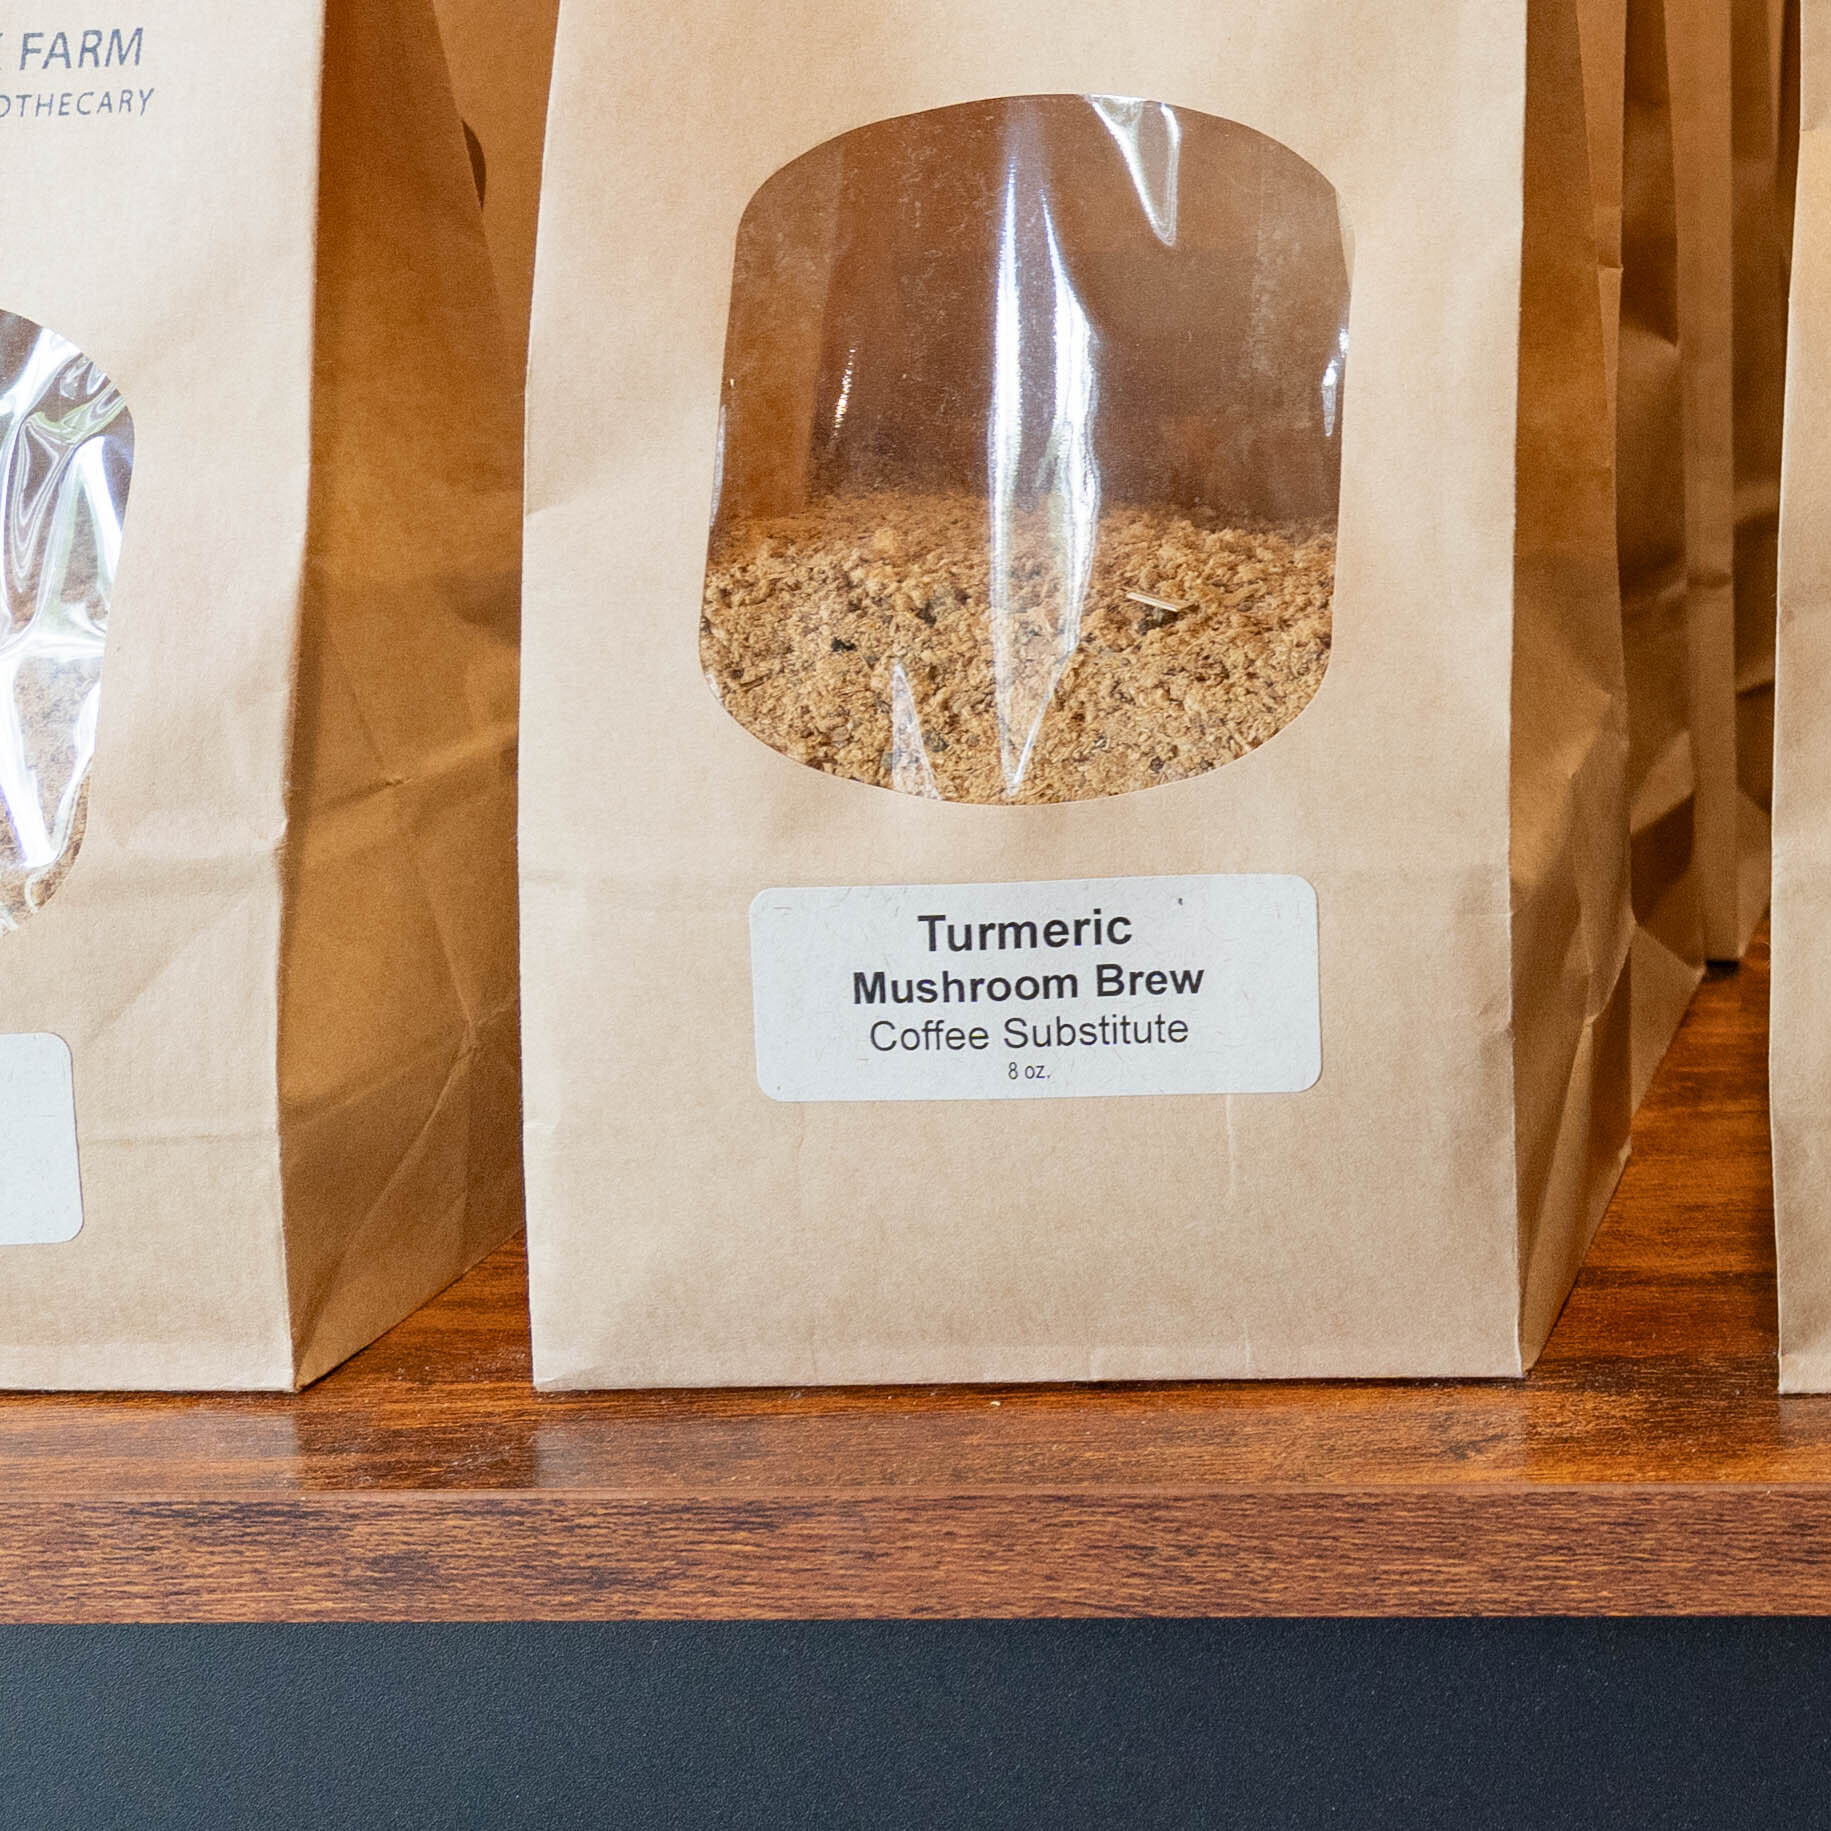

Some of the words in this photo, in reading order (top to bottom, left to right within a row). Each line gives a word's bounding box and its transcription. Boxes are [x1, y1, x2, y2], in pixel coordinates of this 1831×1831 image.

[18, 26, 144, 71] FARM
[0, 87, 156, 119] OTHECARY
[916, 907, 1134, 953] Turmeric
[852, 969, 1079, 1006] Mushroom
[1094, 962, 1206, 998] Brew
[869, 1018, 990, 1053] Coffee
[1002, 1012, 1190, 1050] Substitute
[1007, 1060, 1020, 1081] 8
[1023, 1064, 1050, 1080] oz.
